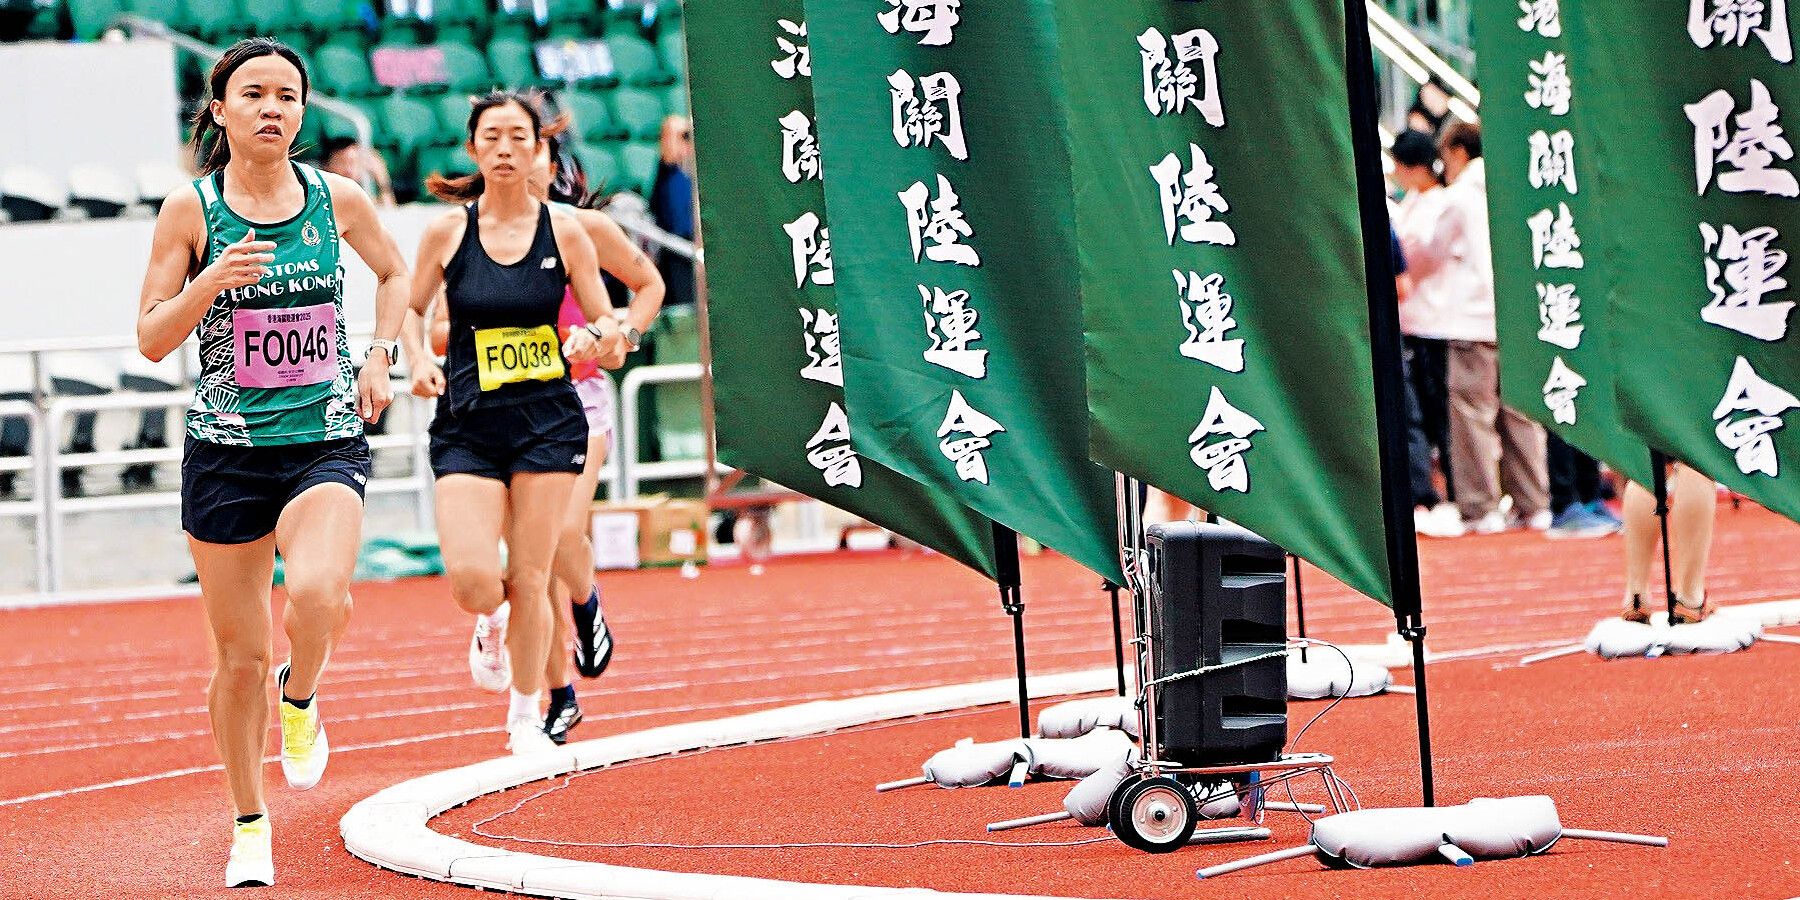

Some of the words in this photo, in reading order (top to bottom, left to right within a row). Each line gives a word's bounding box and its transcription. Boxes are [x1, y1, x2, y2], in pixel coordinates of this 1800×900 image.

[259, 259, 319, 279] STOMS
[1136, 26, 1266, 493] 關陸運會
[230, 281, 285, 302] HONG
[288, 273, 335, 293] KONG
